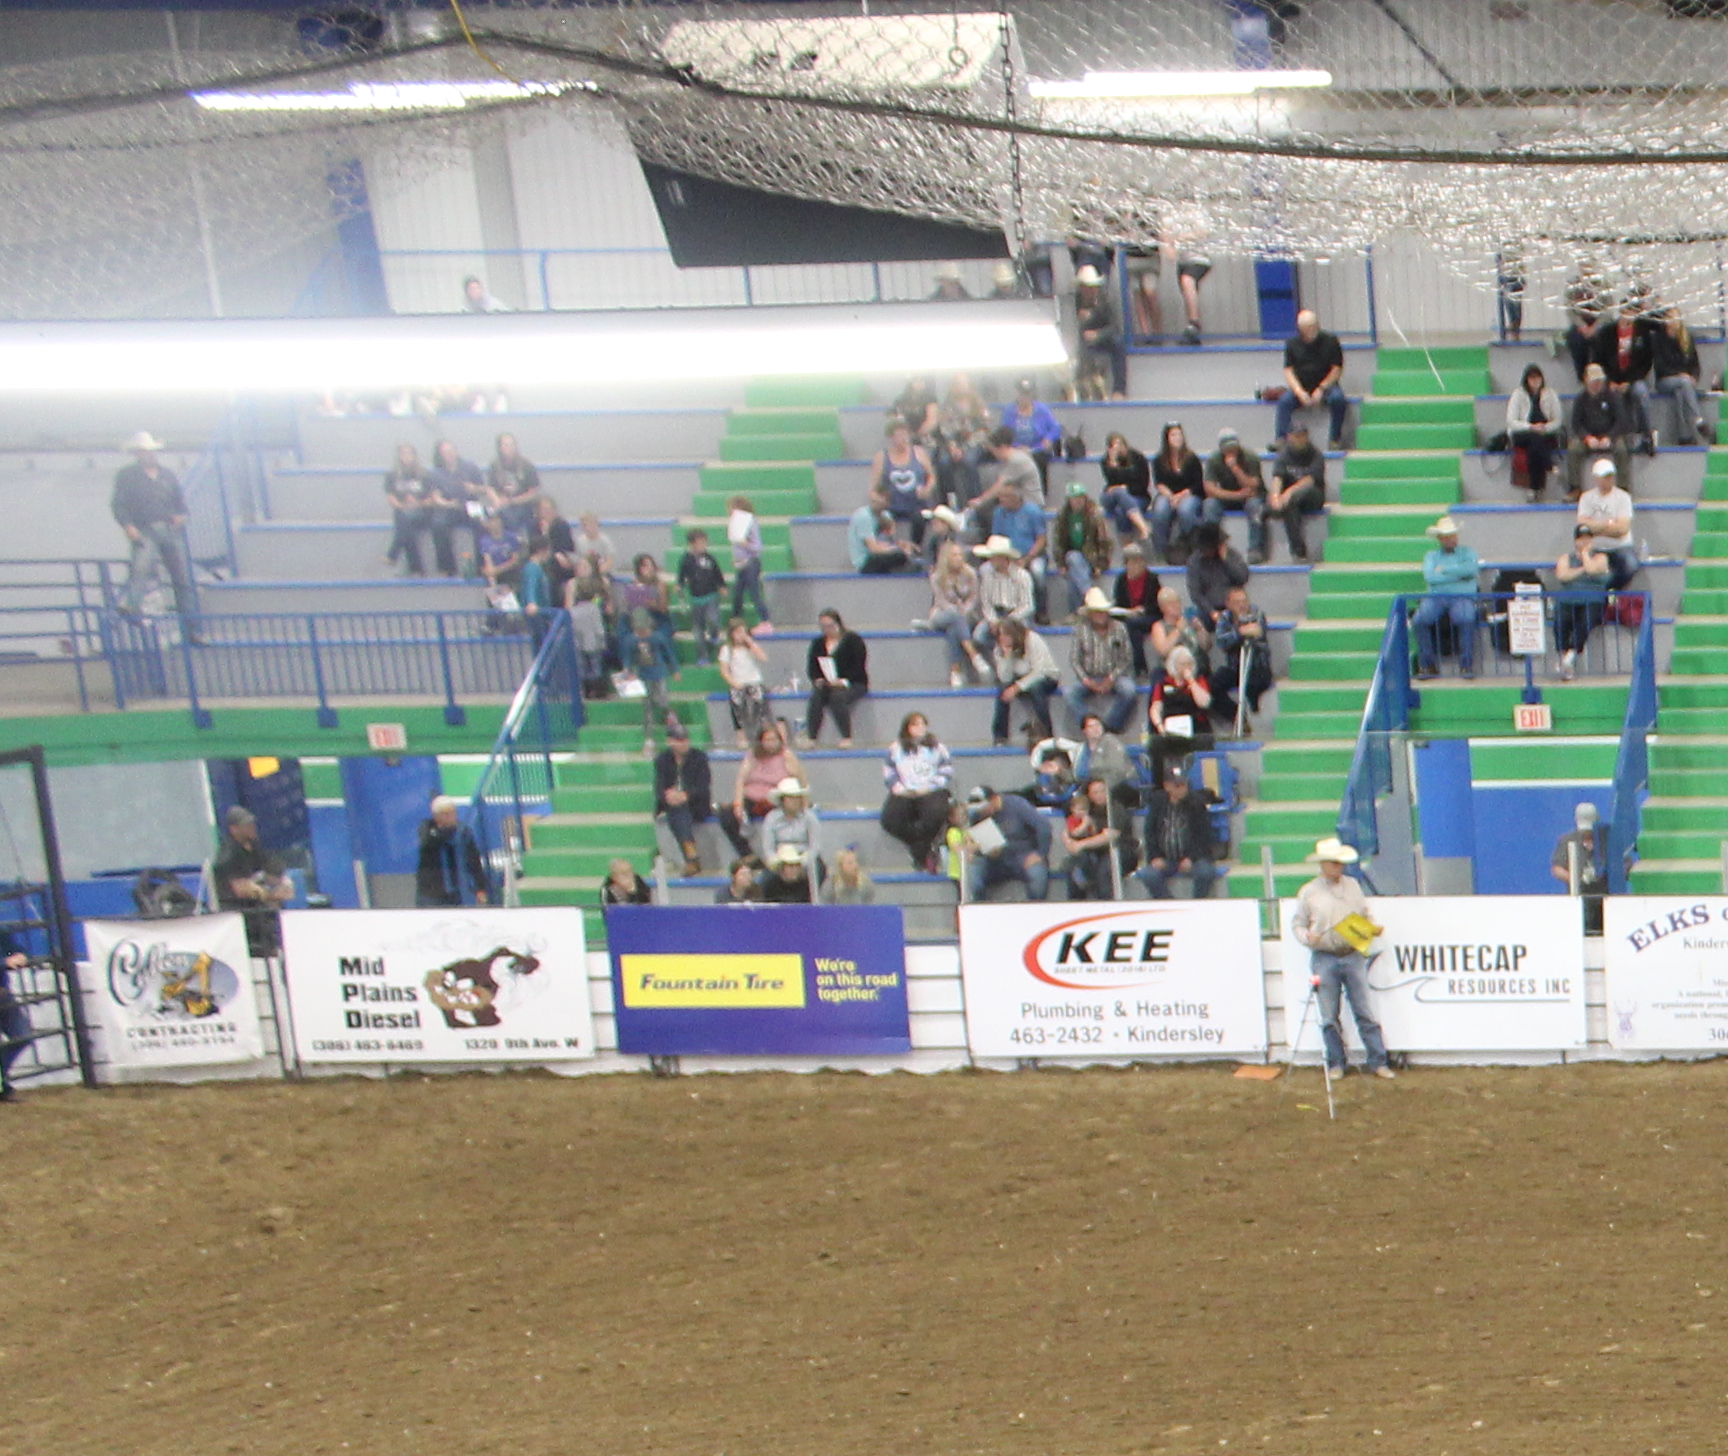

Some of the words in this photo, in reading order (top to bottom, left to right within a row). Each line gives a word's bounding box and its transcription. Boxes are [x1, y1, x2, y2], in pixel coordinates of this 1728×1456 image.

[1626, 904, 1710, 953] ELKS
[1056, 930, 1174, 964] KEE
[339, 957, 385, 976] Mid
[814, 958, 855, 972] We're
[1394, 945, 1527, 973] WHITECAP
[640, 973, 738, 990] Fountain
[744, 973, 784, 990] Tire
[816, 975, 833, 986] on
[836, 973, 861, 986] this
[865, 972, 898, 986] road
[1448, 979, 1536, 994] RESOURCES
[1545, 978, 1571, 993] INC
[341, 984, 418, 1001] Plains
[345, 1009, 421, 1029] Diesel
[1021, 1002, 1104, 1020] Plumbing
[1114, 1001, 1126, 1018] &
[1137, 1001, 1210, 1019] Heating
[1010, 1027, 1103, 1044] 463-2432
[1128, 1026, 1224, 1043] Kindersley
